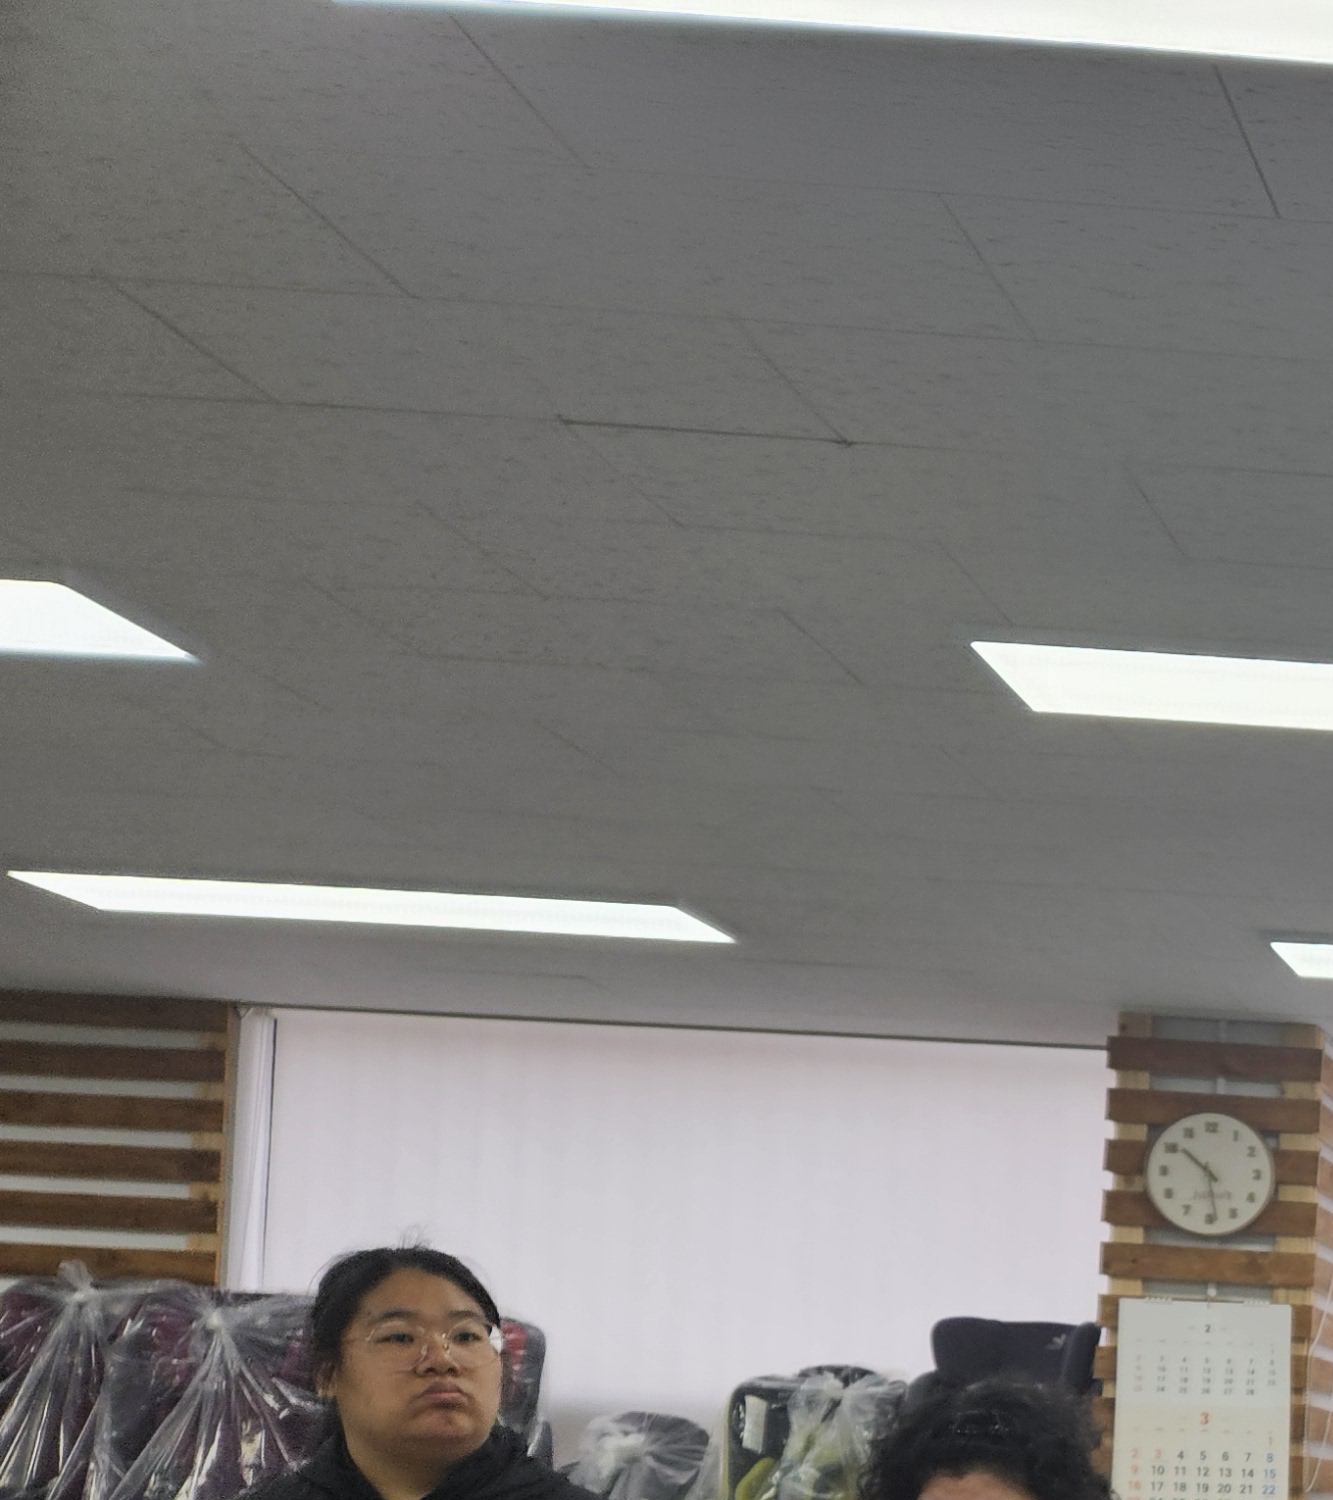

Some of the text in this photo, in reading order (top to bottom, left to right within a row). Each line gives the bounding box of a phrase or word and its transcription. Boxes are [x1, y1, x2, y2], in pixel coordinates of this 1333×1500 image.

[1247, 1146, 1256, 1158] 2
[1252, 1168, 1262, 1181] 3
[1182, 1204, 1191, 1216] 7
[1204, 1324, 1211, 1333] 2
[1201, 1412, 1209, 1425] 3
[1268, 1436, 1272, 1446] 1
[1131, 1448, 1274, 1462] 2 3 4 5 6 7 8
[1130, 1464, 1276, 1479] 9 10 11 12 13 14 15
[1128, 1480, 1276, 1495] 16 17 18 19 20 21 22
